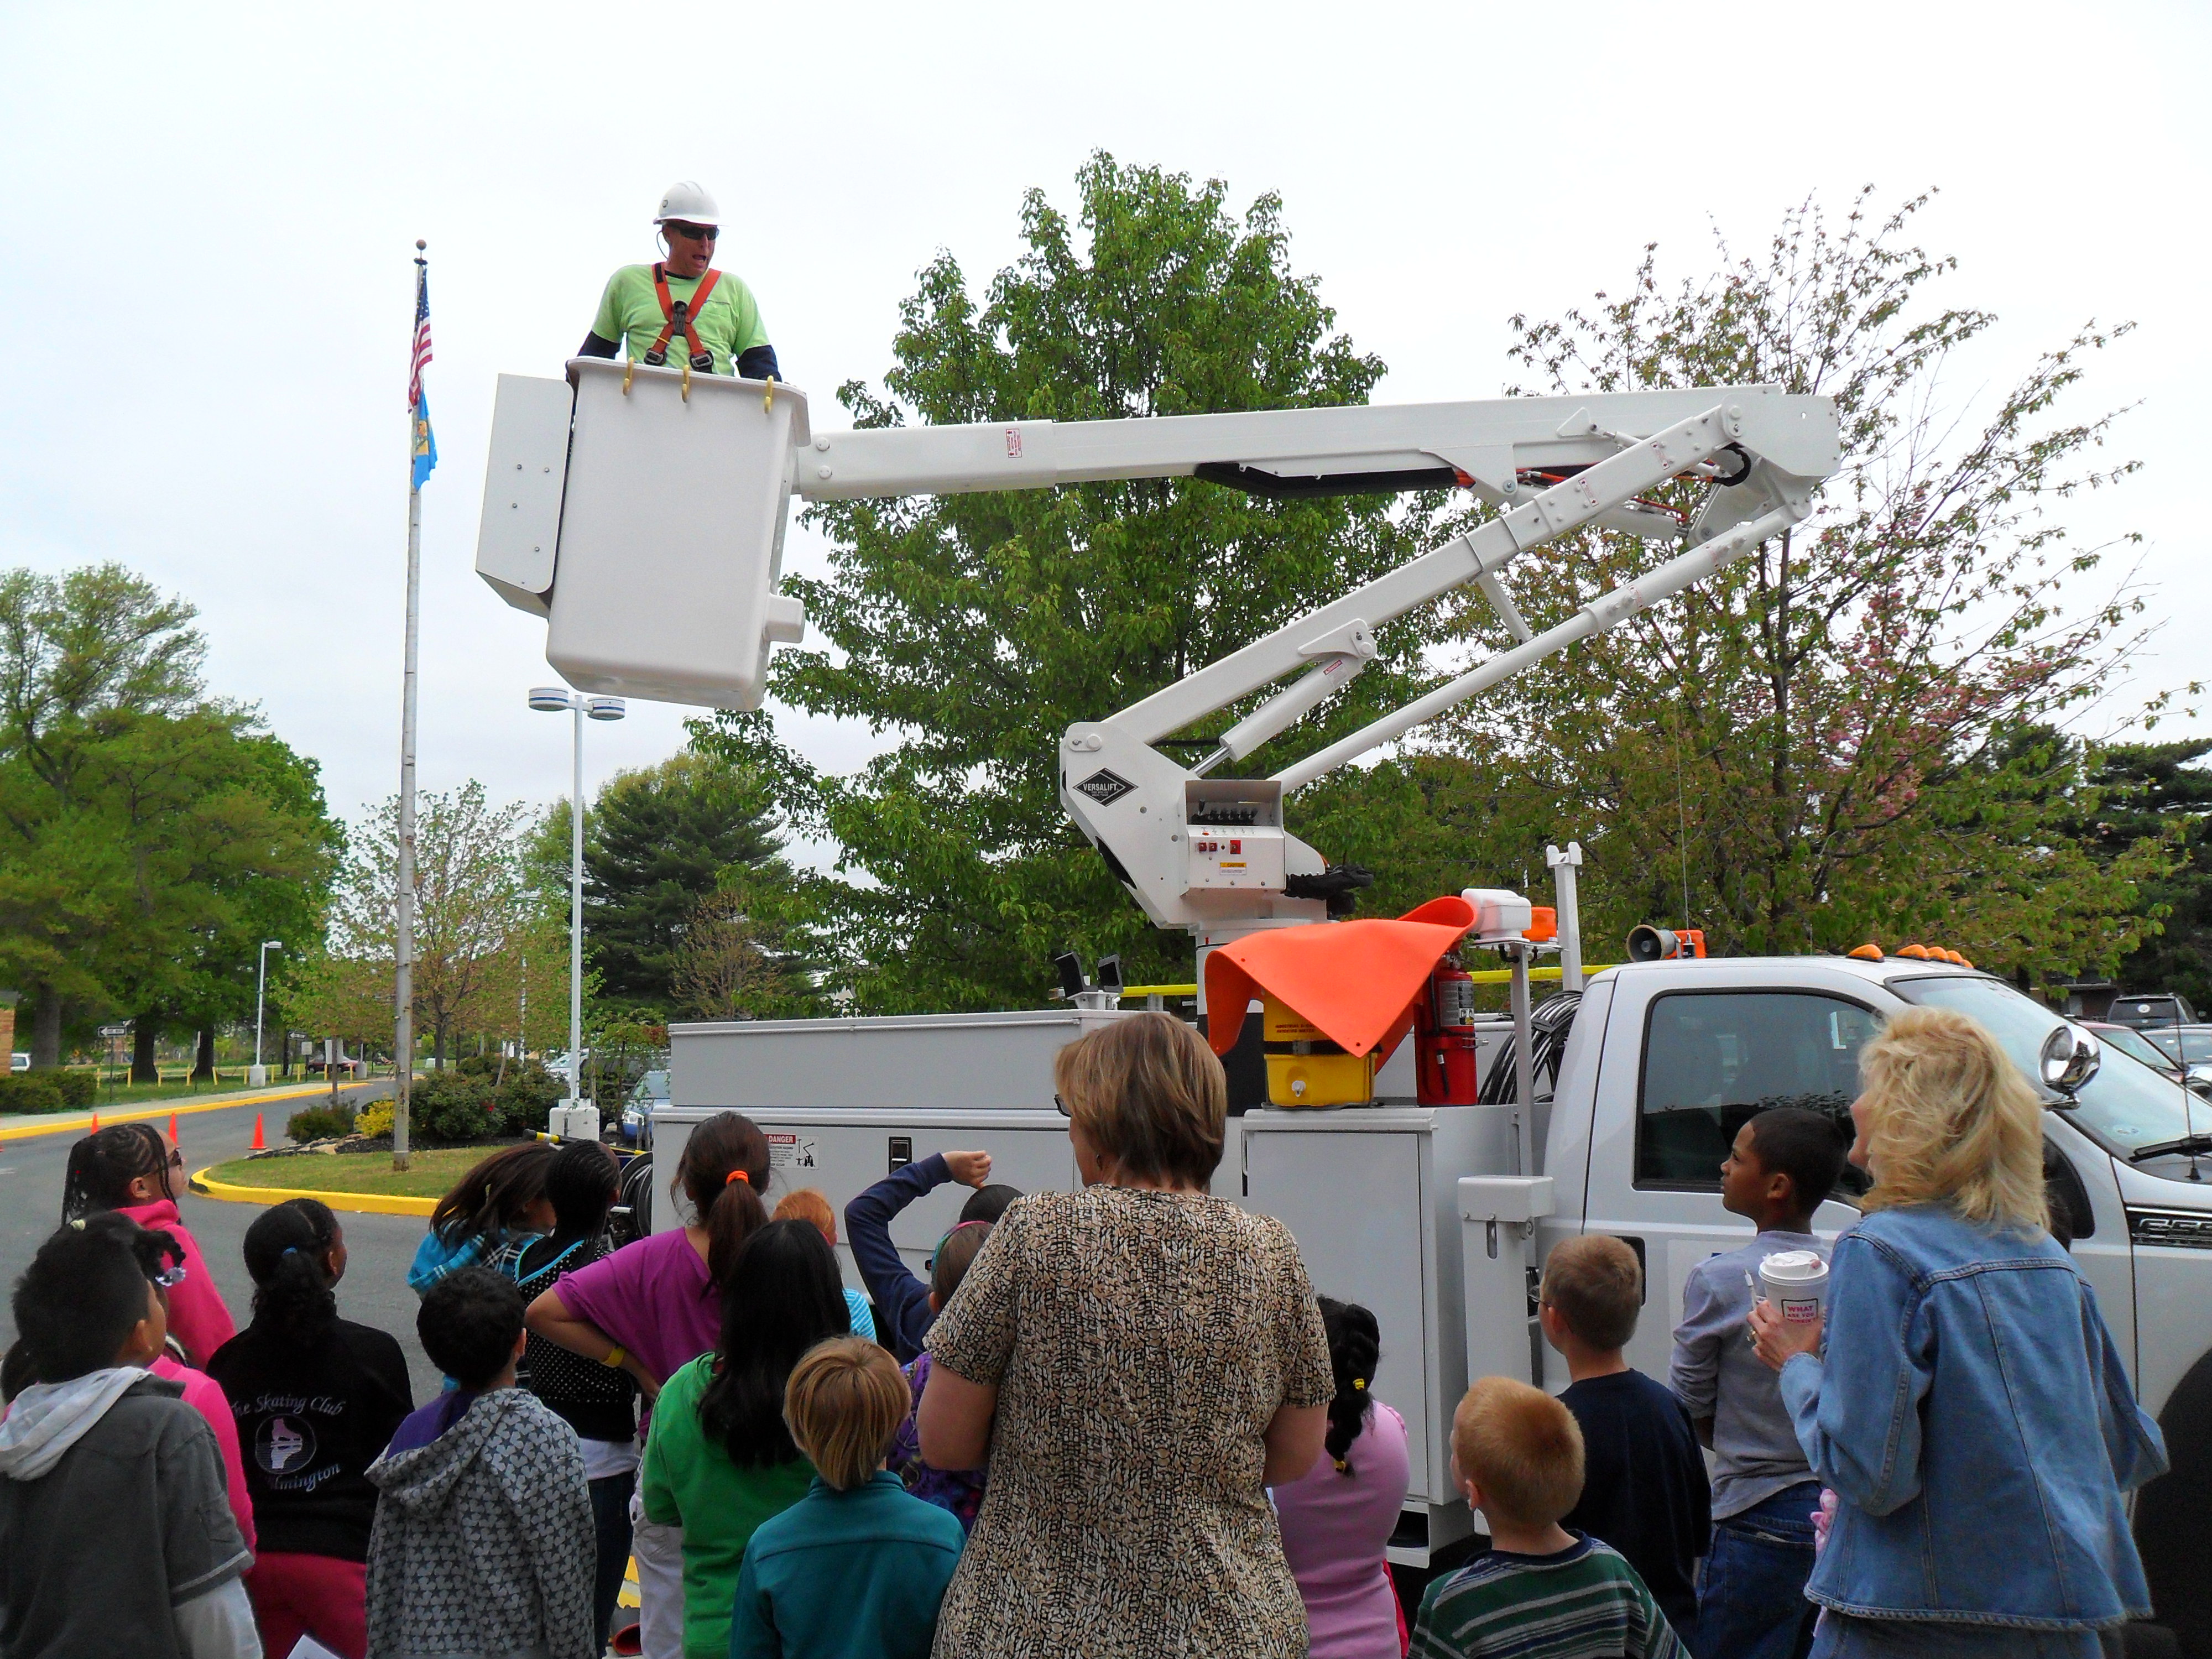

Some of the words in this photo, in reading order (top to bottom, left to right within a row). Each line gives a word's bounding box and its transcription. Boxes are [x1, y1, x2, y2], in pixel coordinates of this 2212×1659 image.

[1083, 783, 1118, 791] VERSALIFT
[255, 1394, 305, 1414] Skating
[310, 1396, 346, 1416] Club
